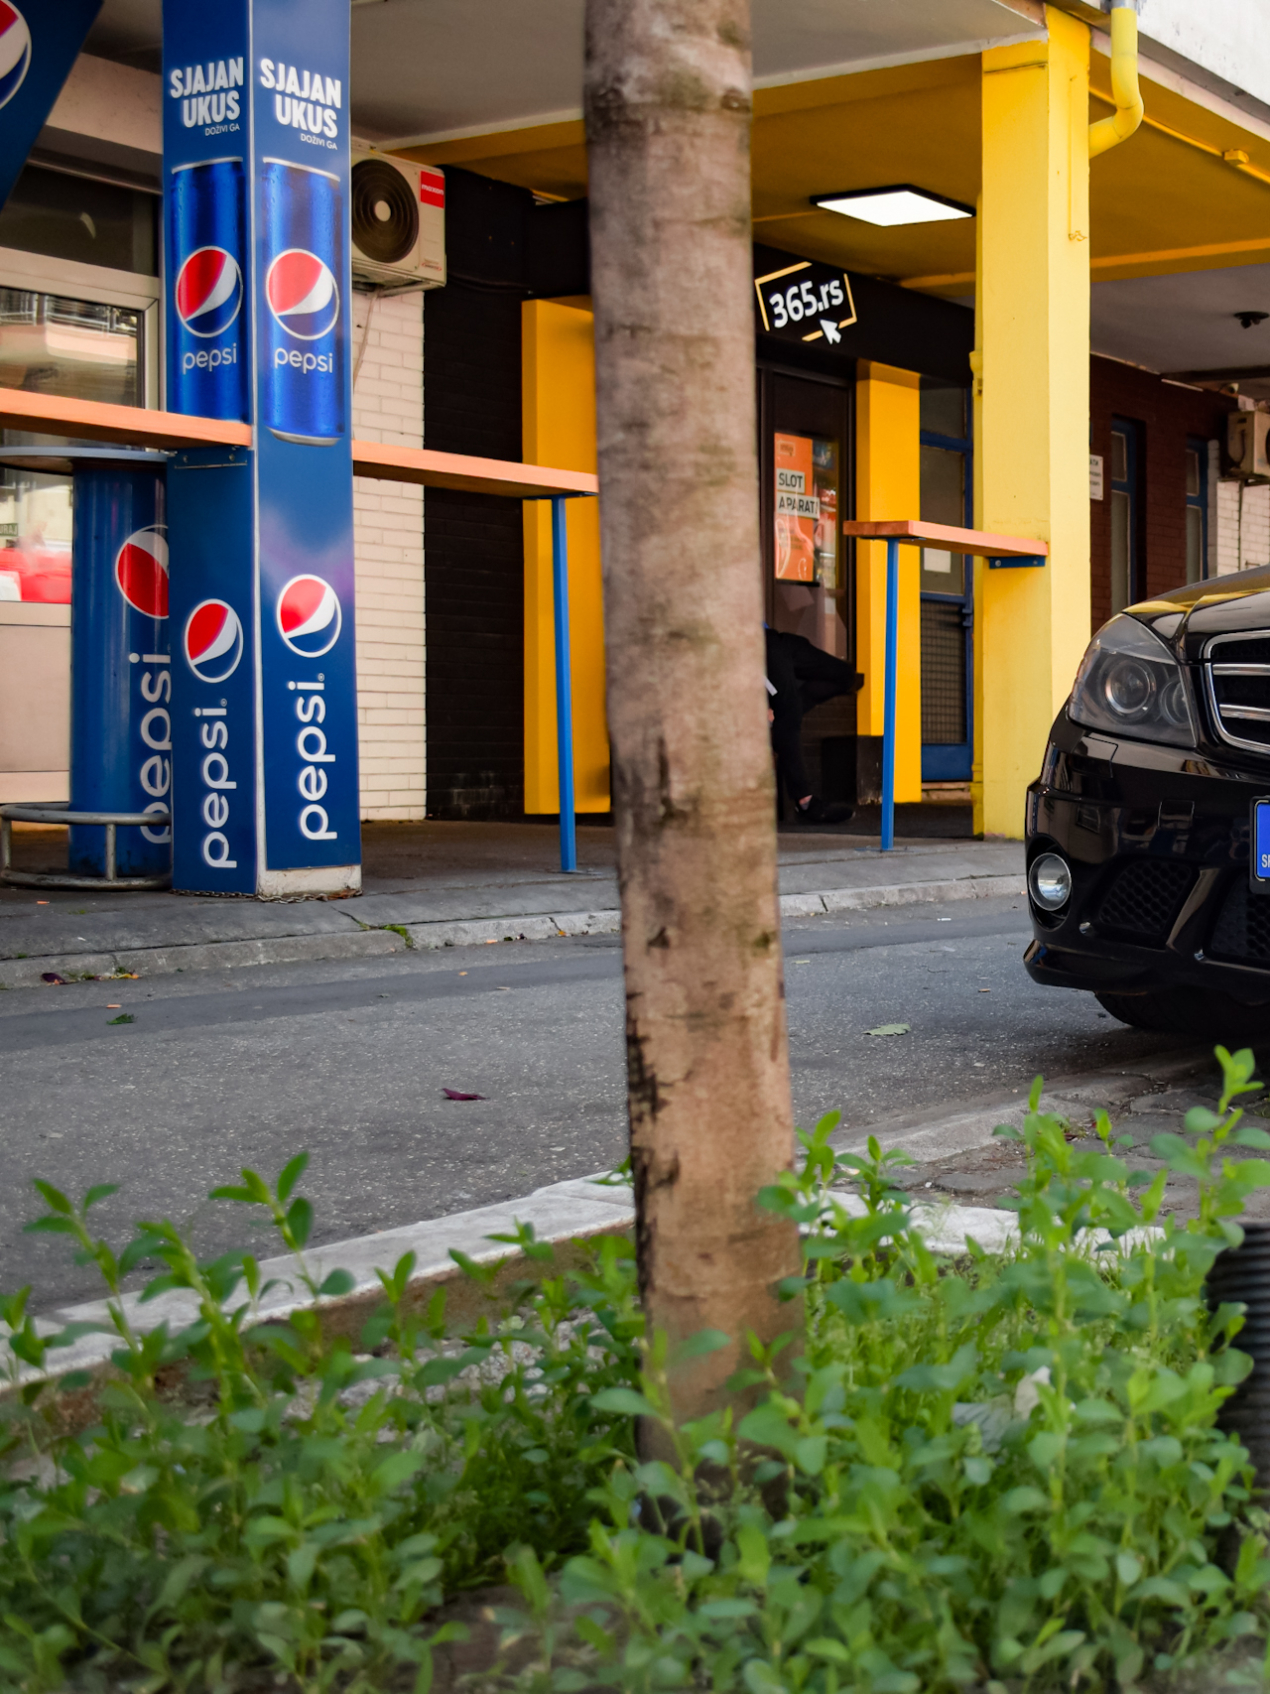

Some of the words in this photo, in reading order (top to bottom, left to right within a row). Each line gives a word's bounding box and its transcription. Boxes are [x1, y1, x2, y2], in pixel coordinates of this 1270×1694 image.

[170, 57, 243, 98] SJAJAN
[260, 58, 342, 109] SJAJAN
[183, 90, 241, 128] UKUS
[275, 94, 338, 139] UKUS
[204, 124, 229, 136] DOŽIVI
[229, 123, 241, 132] GA
[300, 133, 326, 147] DOŽIVI
[326, 140, 338, 150] GA
[769, 280, 844, 328] 365.rs
[182, 343, 237, 375] pepsi
[274, 347, 333, 374] pepsi
[778, 472, 803, 489] SLOT
[288, 681, 337, 840] pepsi
[194, 707, 237, 869] pepsi
